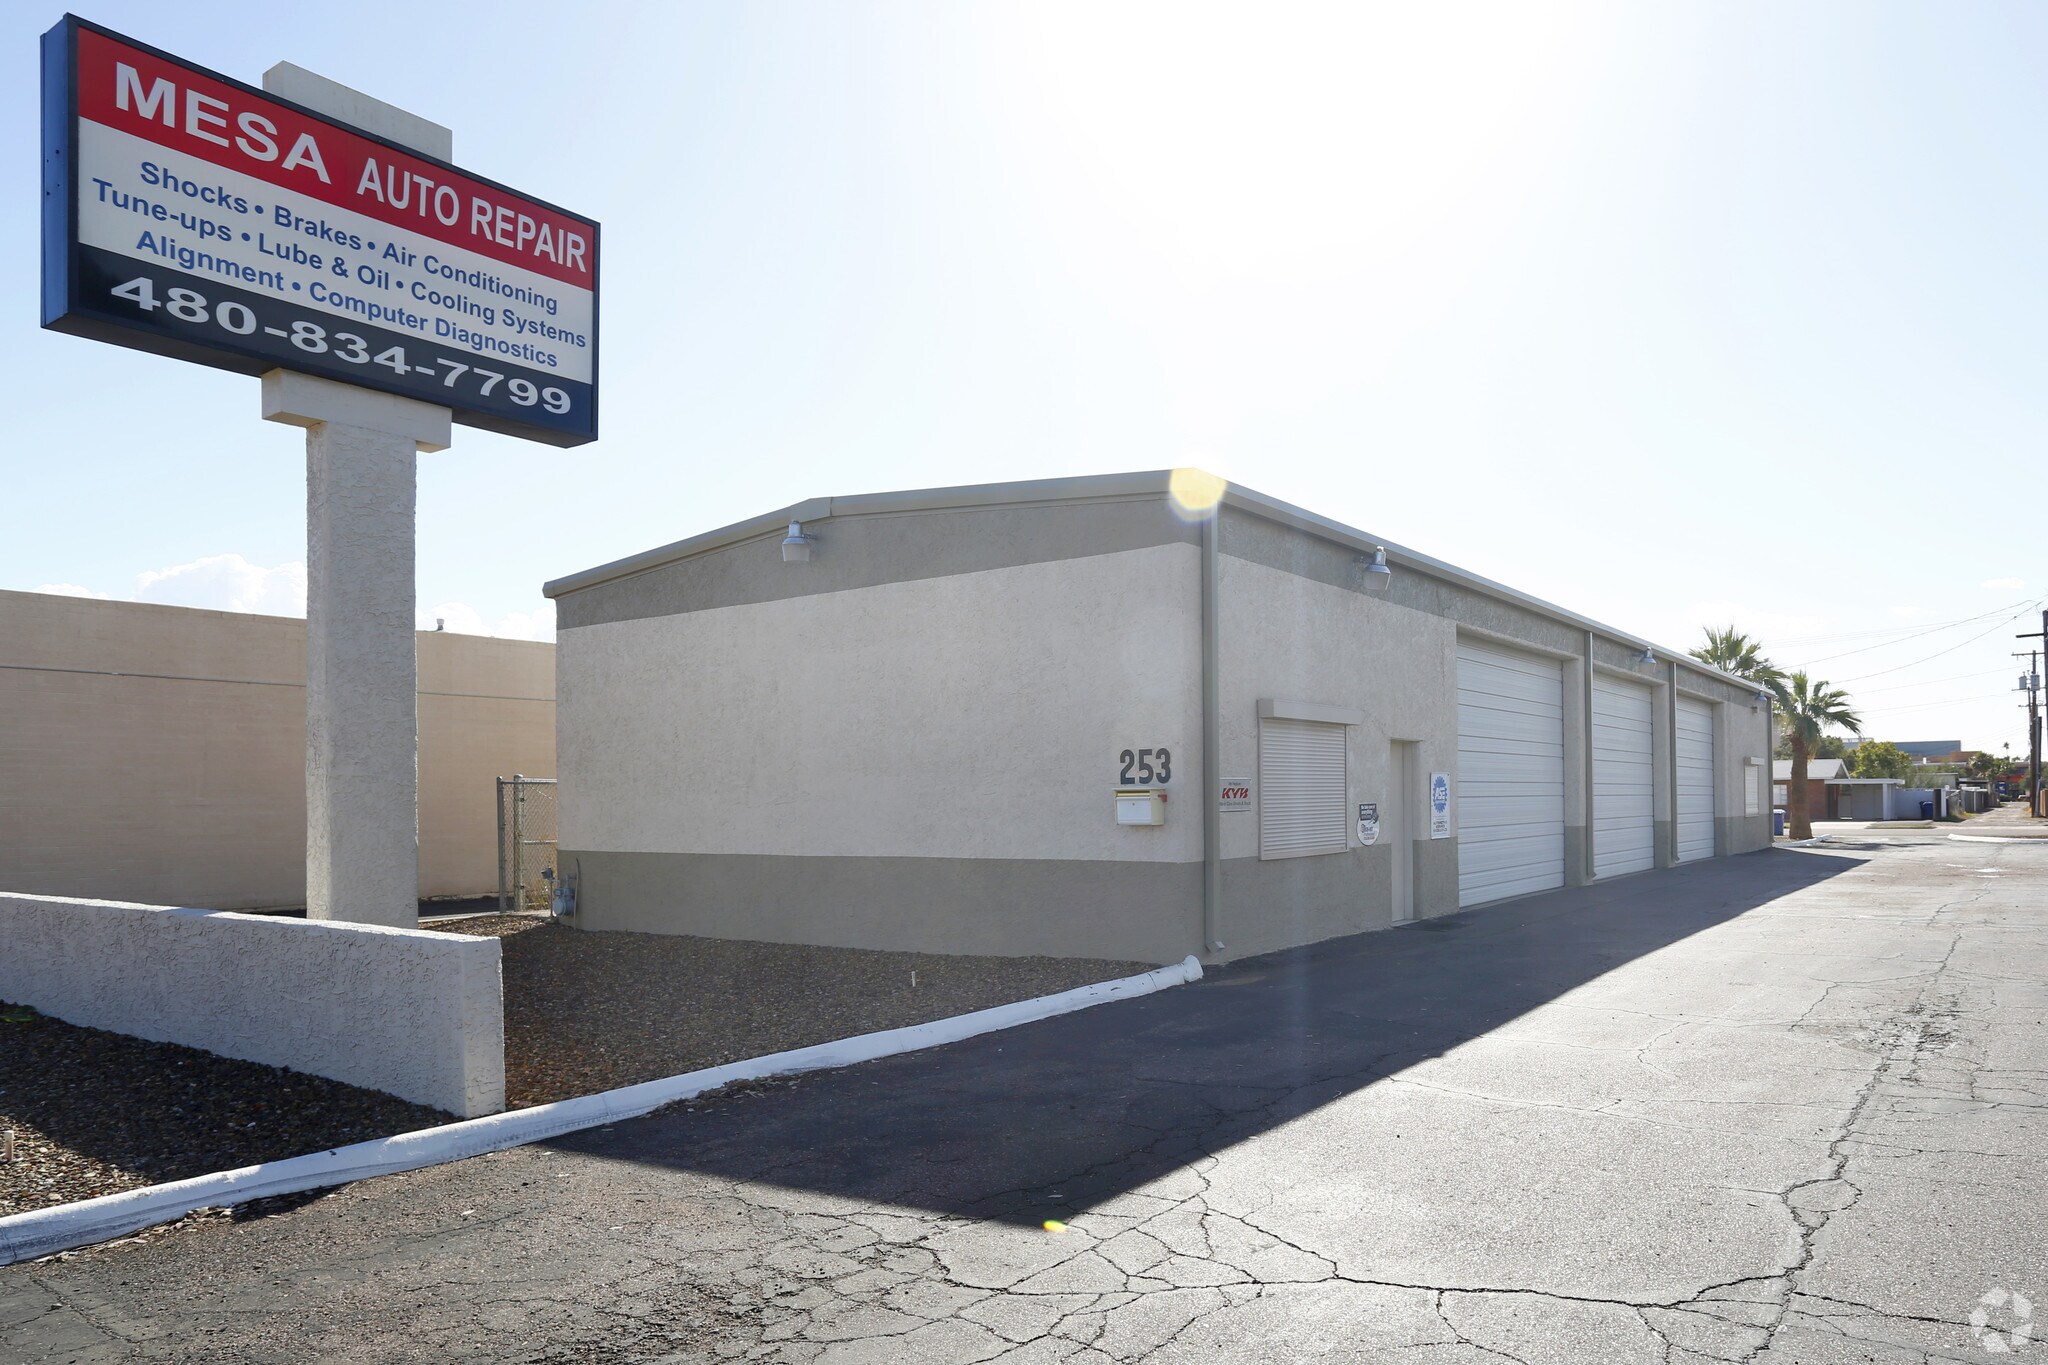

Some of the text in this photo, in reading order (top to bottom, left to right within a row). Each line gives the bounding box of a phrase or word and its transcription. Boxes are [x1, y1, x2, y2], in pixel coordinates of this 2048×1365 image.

[115, 61, 587, 272] MESA AUTO REPAIR
[92, 177, 587, 348] Tune-ups Lube & Oil Cooling Systems
[135, 230, 558, 367] Alignment Computer Diagnostics
[140, 161, 558, 315] Shocks Brakes Air Conditioning
[110, 276, 572, 415] 480-834-7799
[1119, 747, 1171, 785] 253
[1221, 787, 1249, 799] KYB
